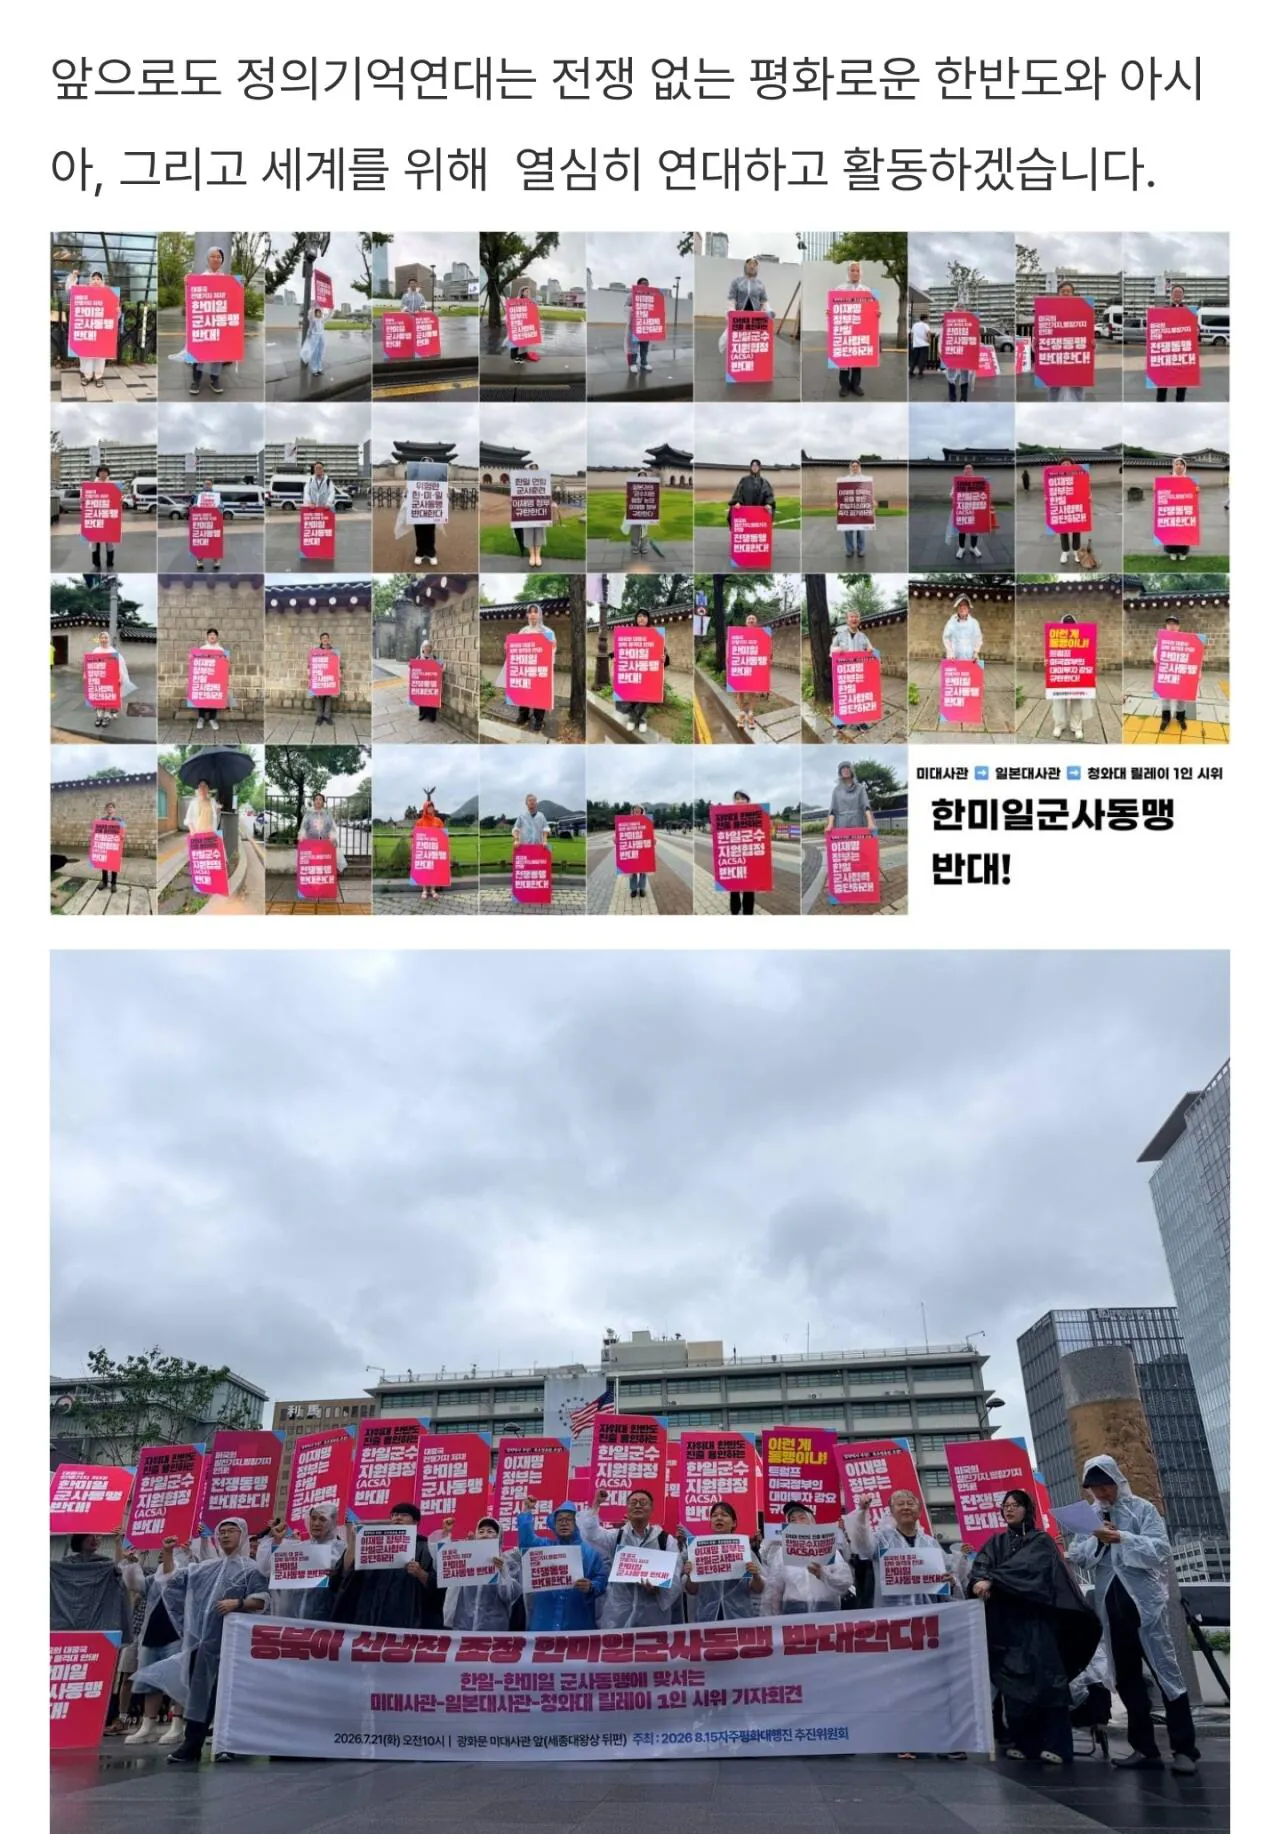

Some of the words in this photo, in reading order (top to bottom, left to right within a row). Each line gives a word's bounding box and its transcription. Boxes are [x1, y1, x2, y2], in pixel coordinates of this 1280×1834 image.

[53, 57, 221, 99] 앞으로도
[238, 57, 536, 100] 정의기억연대는
[553, 57, 632, 100] 전쟁
[652, 57, 734, 100] 없는
[750, 57, 920, 100] 평화로운
[936, 56, 1106, 100] 한반도와
[1122, 57, 1200, 100] 아시
[52, 147, 102, 197] 아,
[120, 147, 246, 191] 그리고
[263, 147, 389, 191] 세계를
[405, 147, 485, 191] 위해
[517, 147, 638, 191] 열심히
[659, 147, 828, 191] 연대하고
[844, 147, 1154, 191] 활동하겠습니다.
[192, 300, 227, 313] 한미일
[192, 314, 239, 328] 군사동맹
[192, 329, 220, 342] 반대!
[917, 768, 968, 779] 미대사관
[996, 768, 1060, 779] 일본대사관
[1088, 768, 1126, 779] 청와대
[1131, 768, 1168, 779] 릴레이
[1174, 768, 1192, 779] 1인
[1198, 768, 1222, 779] 시위
[932, 799, 1173, 830] 한미일군사동맹
[717, 830, 765, 843] 한일군수
[719, 858, 746, 866] (ACSA)
[933, 854, 1010, 884] 반대!
[598, 1445, 660, 1461] 한일군수
[768, 1439, 795, 1451] 이런
[361, 1446, 418, 1462] 한일군수
[504, 1455, 544, 1469] 이재명
[423, 1462, 467, 1480] 한미일
[597, 1463, 658, 1479] 지원협정
[686, 1461, 749, 1477] 한일군수
[846, 1459, 887, 1477] 이재명
[141, 1474, 194, 1492] 한일군수
[212, 1476, 268, 1493] 전쟁동맹
[356, 1478, 391, 1488] (ACSA)
[503, 1471, 542, 1485] 정부는
[595, 1479, 632, 1488] (ACSA)
[686, 1478, 748, 1494] 지원협정
[849, 1476, 892, 1493] 정부는
[421, 1478, 483, 1497] 군사동맹
[209, 1493, 270, 1510] 반대한다!
[355, 1490, 389, 1506] 반대!
[685, 1494, 722, 1503] (ACSA)
[134, 1507, 167, 1518] (ACSA)
[420, 1498, 456, 1516] 반대!
[132, 1519, 165, 1536] 반대!
[460, 1672, 554, 1692] 한일-한미일
[561, 1670, 647, 1691] 군사동맹에
[653, 1670, 705, 1687] 맞서는
[50, 1681, 103, 1700] 사동맹
[371, 1693, 593, 1713] 미대사관-일본대사관-청와대
[599, 1691, 651, 1712] 릴레이
[657, 1691, 686, 1710] 1인
[692, 1689, 727, 1708] 시위
[731, 1685, 803, 1707] 기자회견
[334, 1732, 400, 1747] 2026.7.21(화)
[403, 1734, 445, 1748] 오전10시
[457, 1734, 488, 1748] 광화문
[490, 1734, 531, 1748] 미대사관
[602, 1734, 627, 1747] 뒤편)
[661, 1732, 692, 1744] 2026
[795, 1727, 849, 1741] 추진위원회
